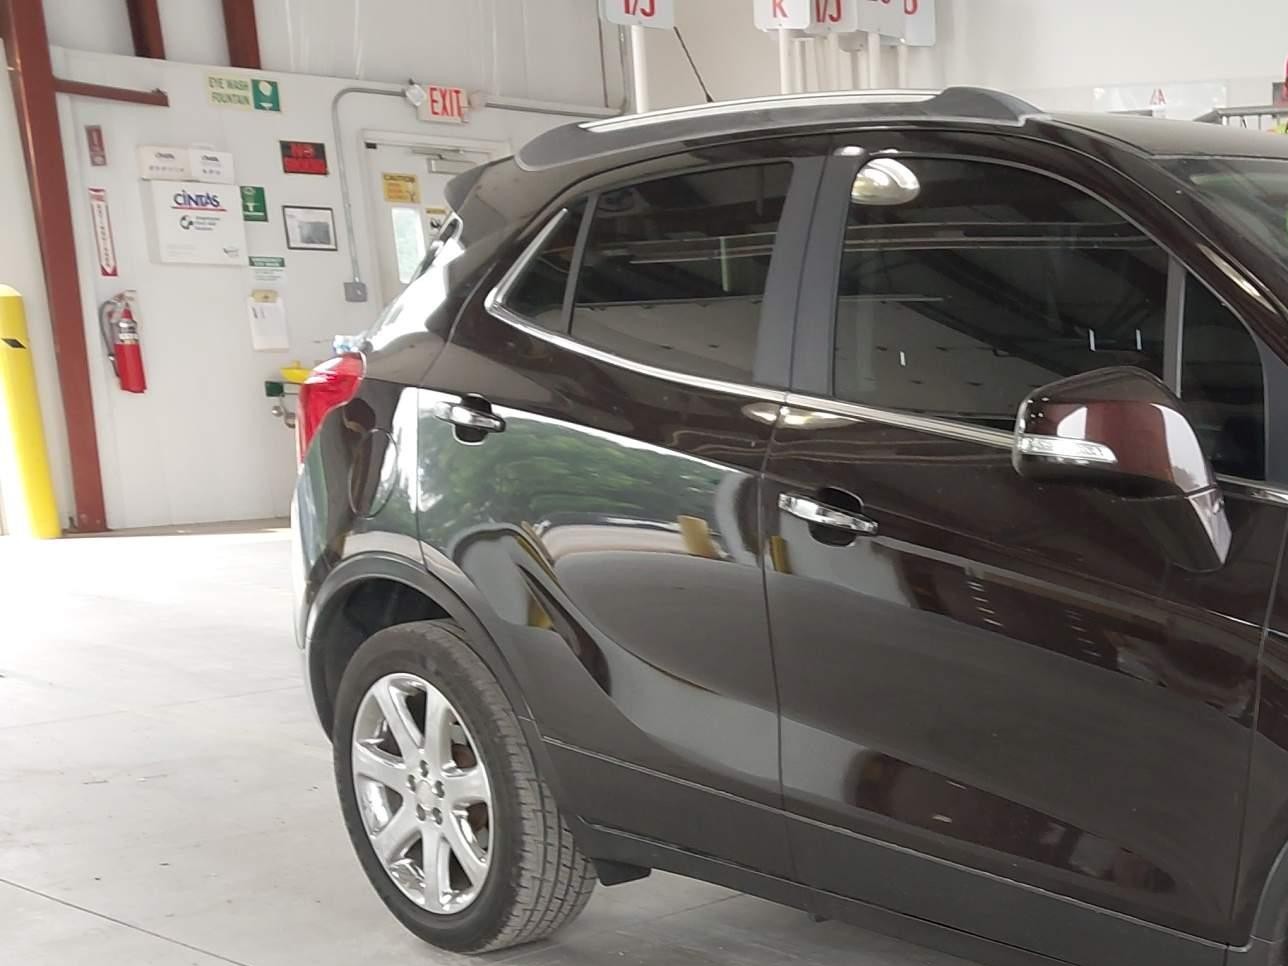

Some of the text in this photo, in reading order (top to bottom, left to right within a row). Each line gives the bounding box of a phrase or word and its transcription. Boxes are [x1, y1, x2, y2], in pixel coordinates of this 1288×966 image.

[208, 76, 249, 91] EYE WASH
[211, 91, 250, 105] FOUNTAIN
[430, 87, 463, 117] EXIT
[173, 189, 221, 208] CINTAS
